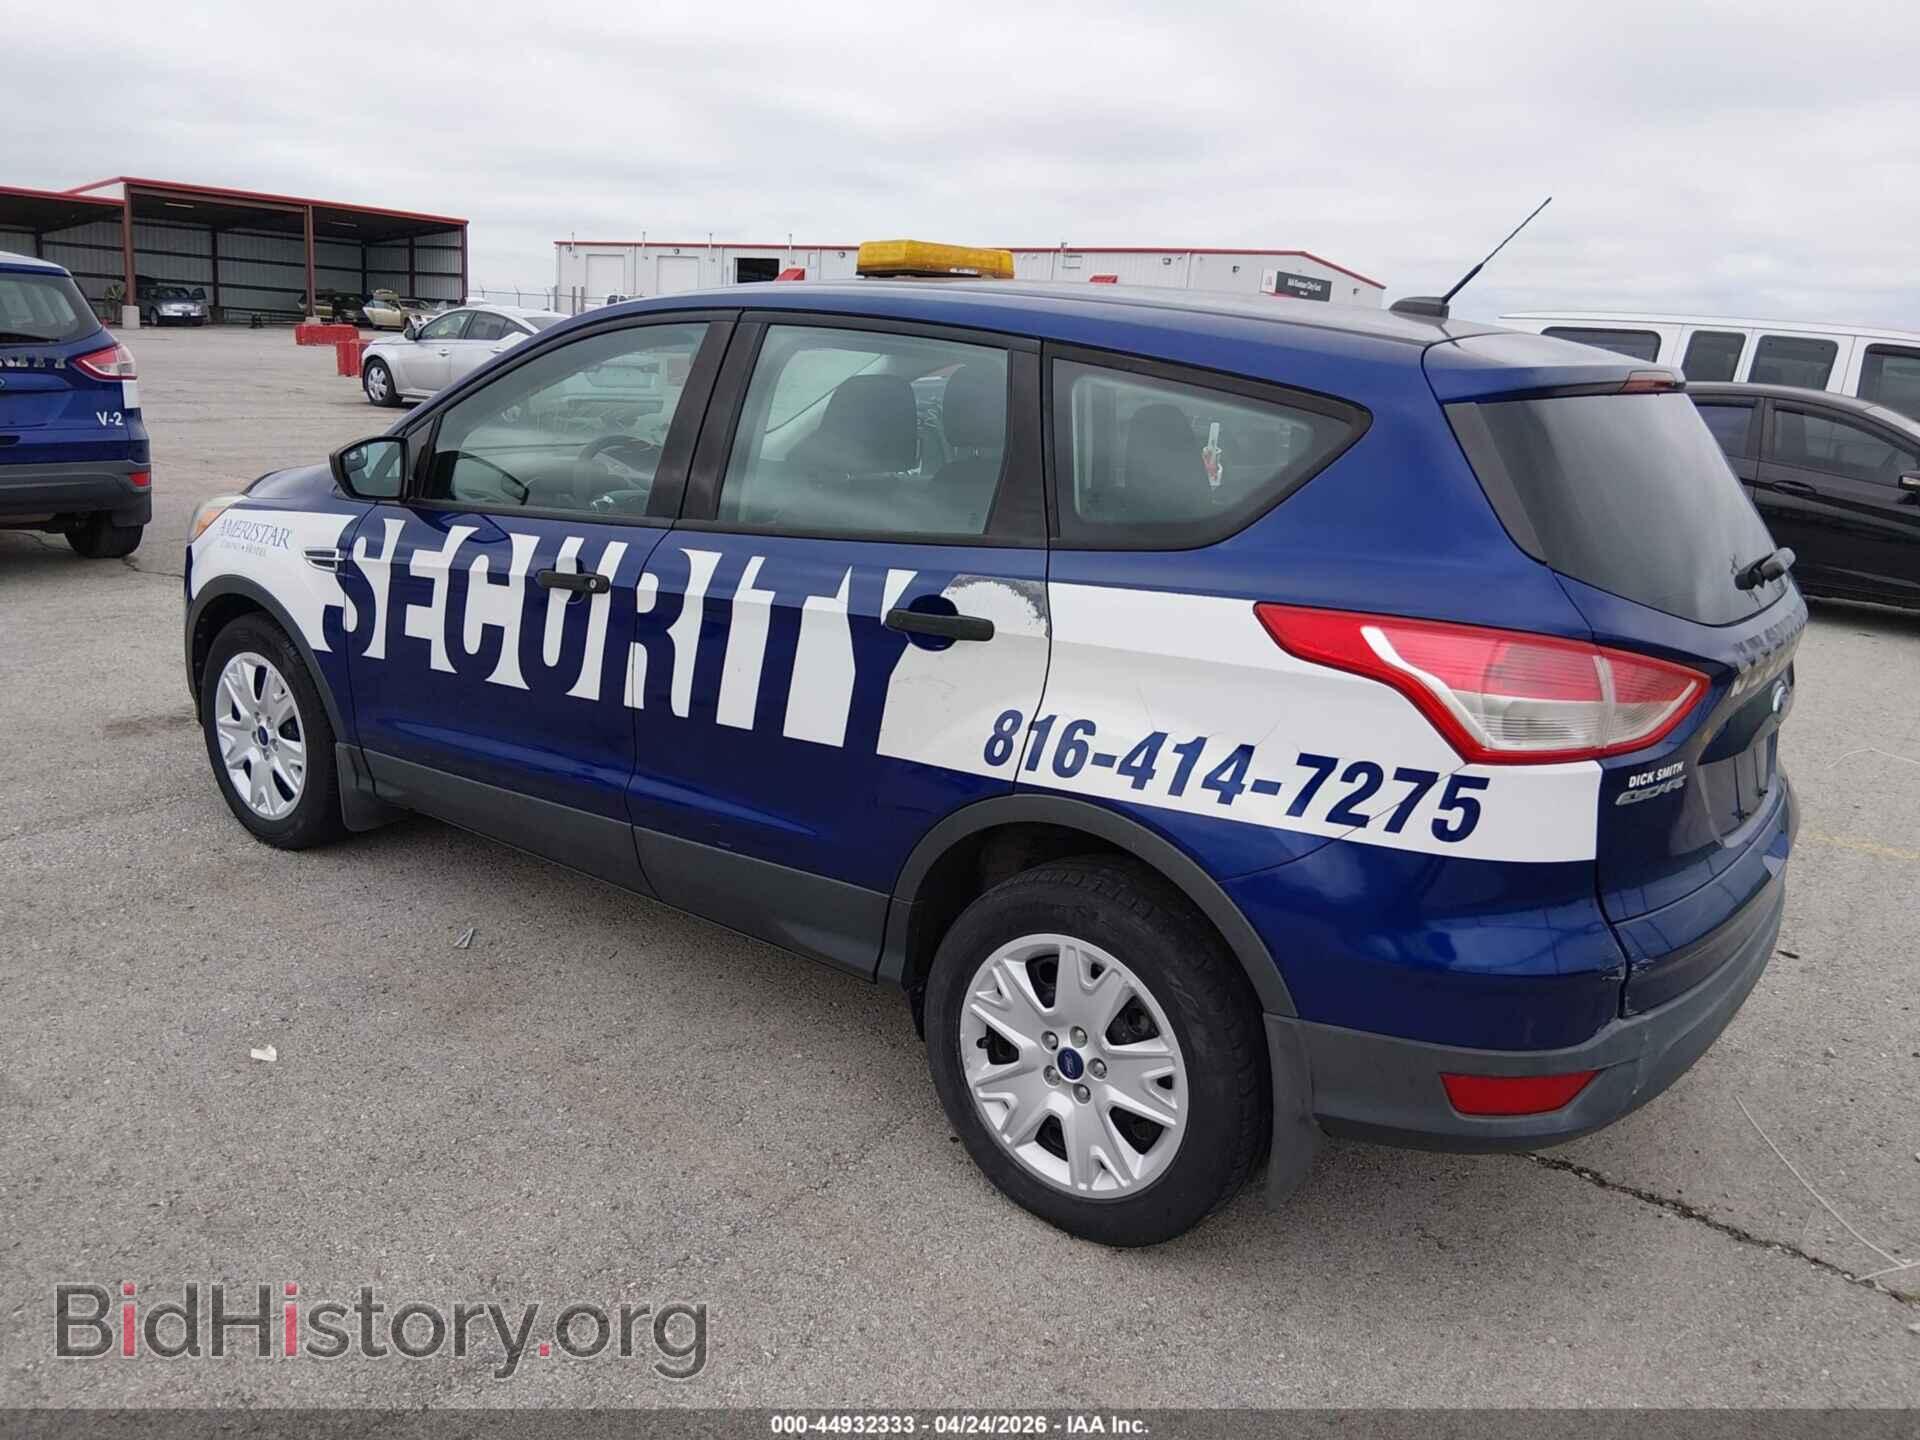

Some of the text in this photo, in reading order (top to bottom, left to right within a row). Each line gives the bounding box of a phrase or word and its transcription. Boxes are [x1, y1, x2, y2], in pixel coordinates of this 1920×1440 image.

[96, 411, 124, 426] V-2
[217, 519, 290, 550] AMERISTAR
[322, 519, 918, 754] SECURITY
[983, 709, 1490, 843] 816-414-7275
[1629, 761, 1685, 788] DICK SMITH
